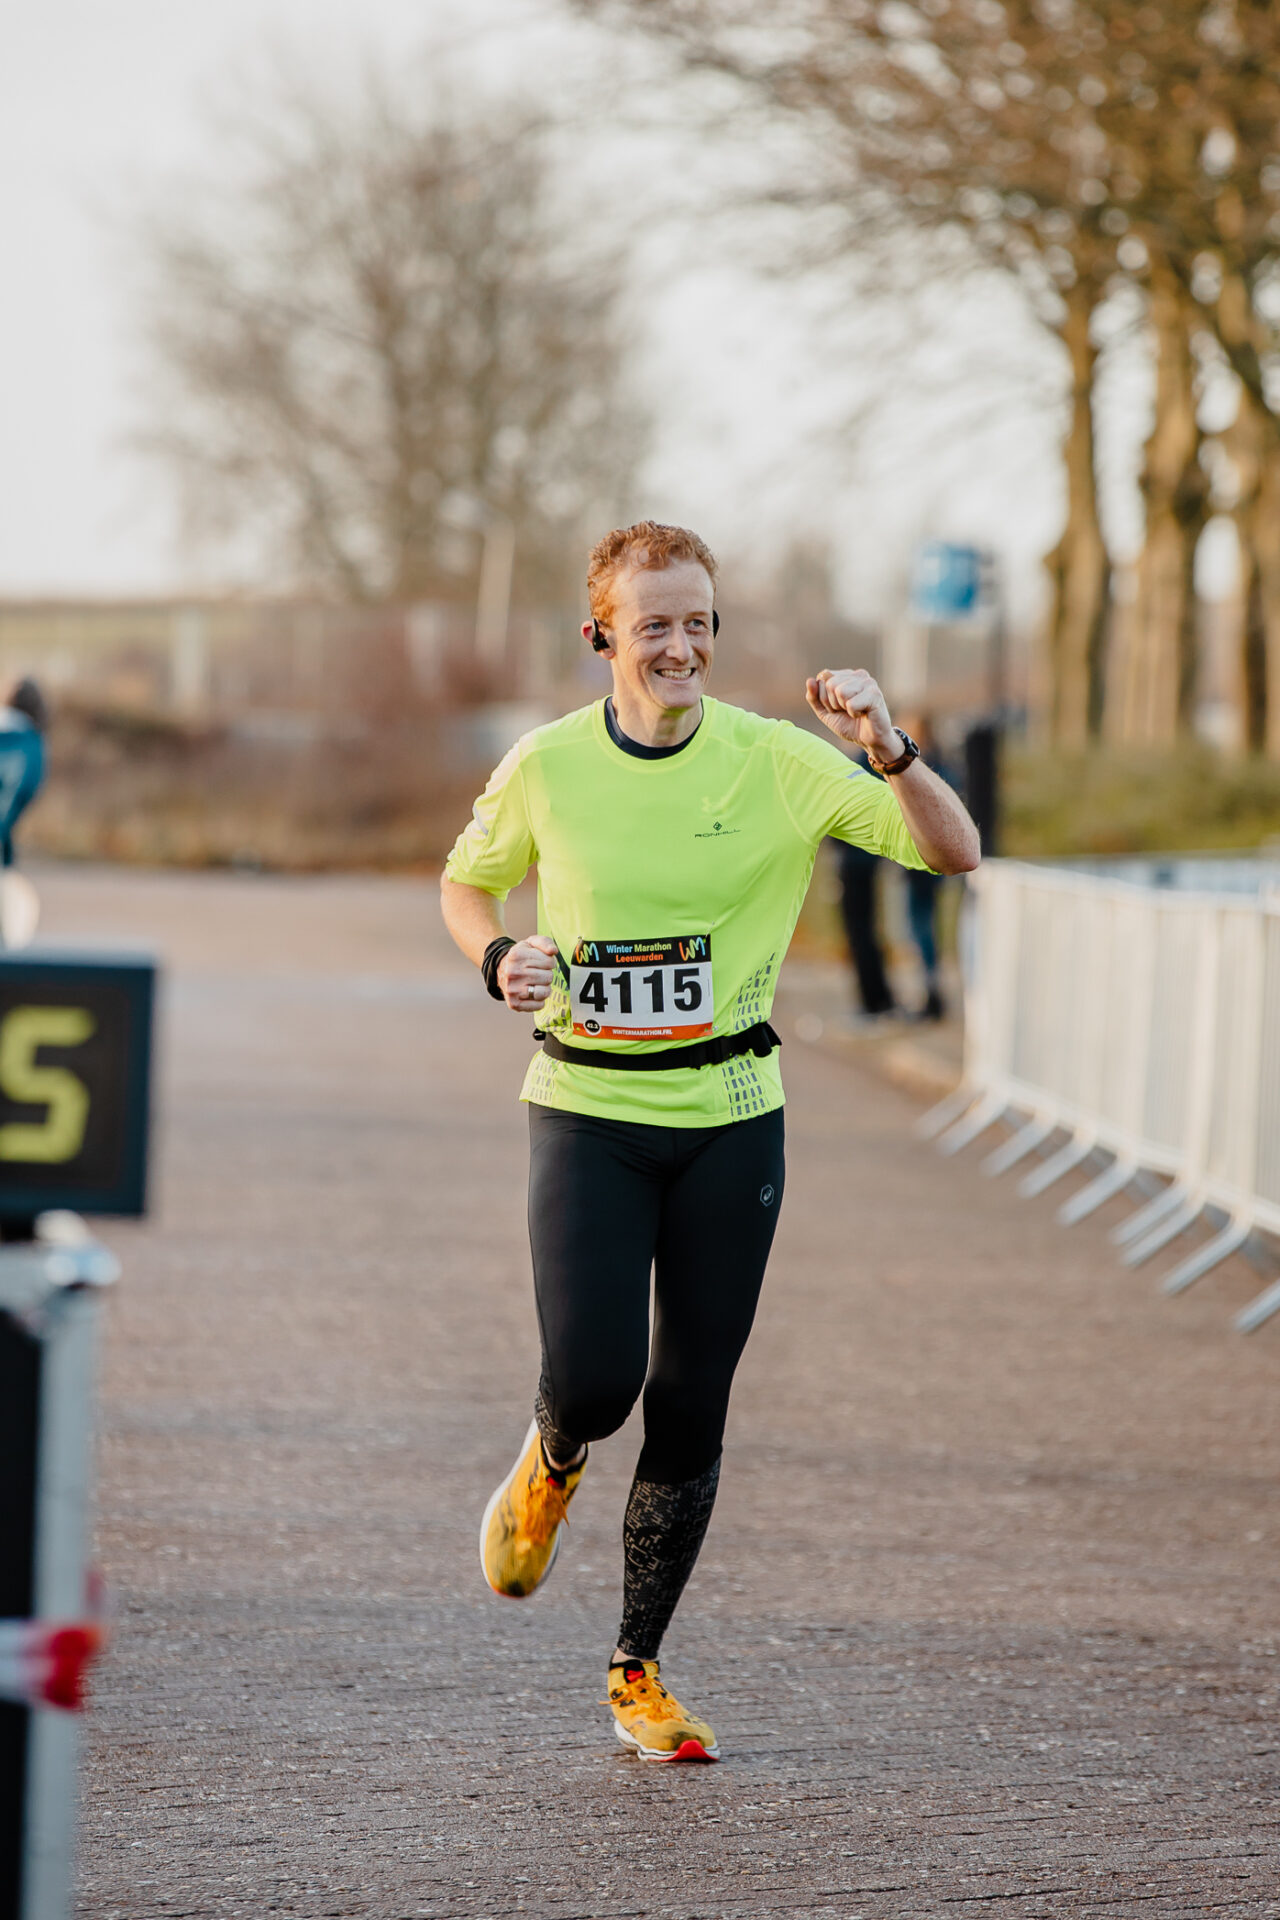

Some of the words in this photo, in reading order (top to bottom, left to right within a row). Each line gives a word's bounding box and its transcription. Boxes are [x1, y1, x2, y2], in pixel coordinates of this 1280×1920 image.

[606, 944, 633, 954] Winter
[634, 942, 672, 953] Marathon
[615, 952, 664, 963] Leeuwarden
[579, 967, 702, 1014] 4115
